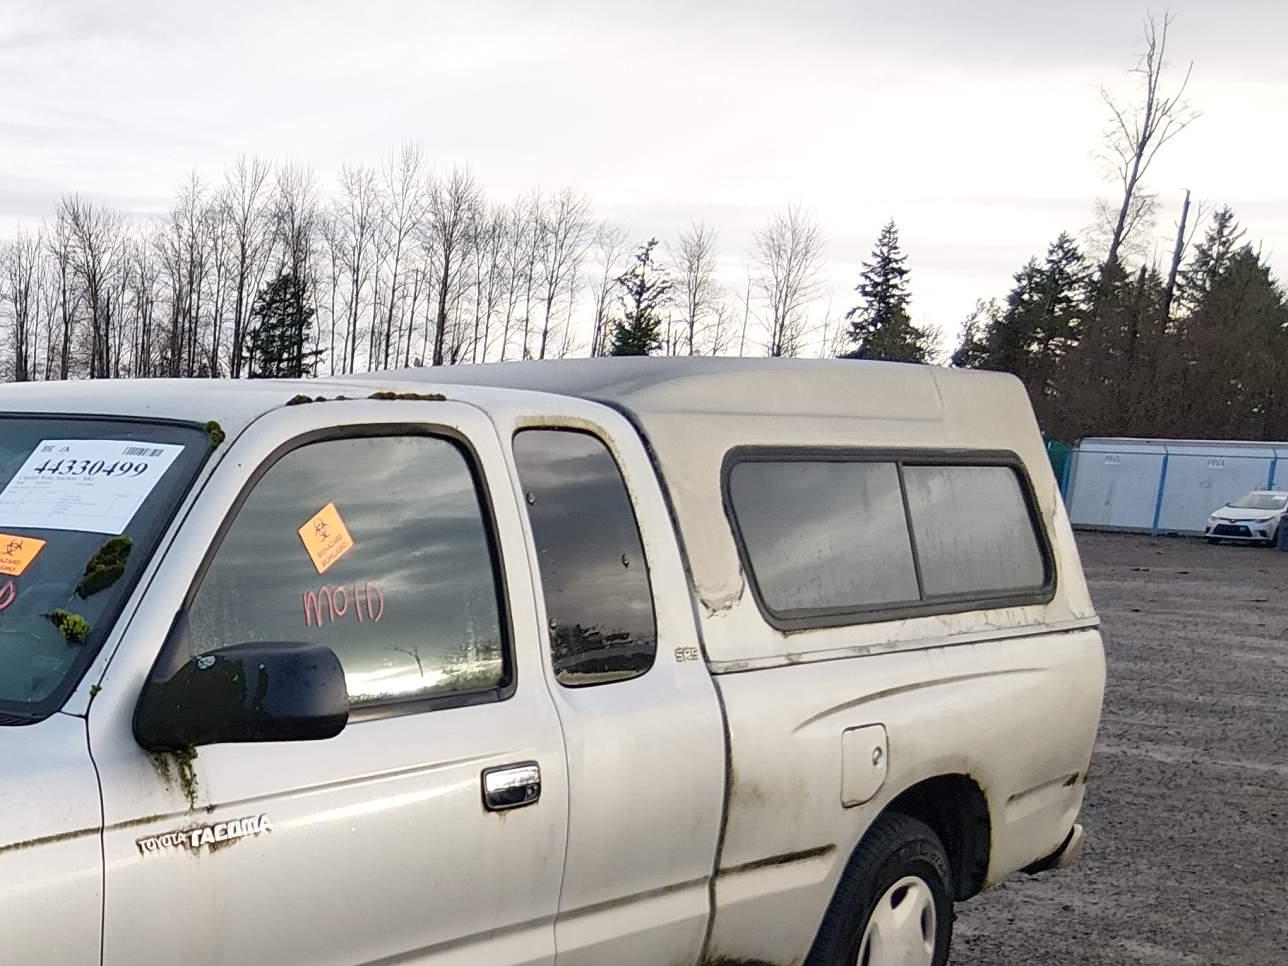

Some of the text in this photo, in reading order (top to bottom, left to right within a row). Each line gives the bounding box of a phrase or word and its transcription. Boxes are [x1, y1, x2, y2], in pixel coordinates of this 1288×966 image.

[33, 458, 149, 478] 44330499
[137, 814, 273, 855] TOYOTA TACOMA
